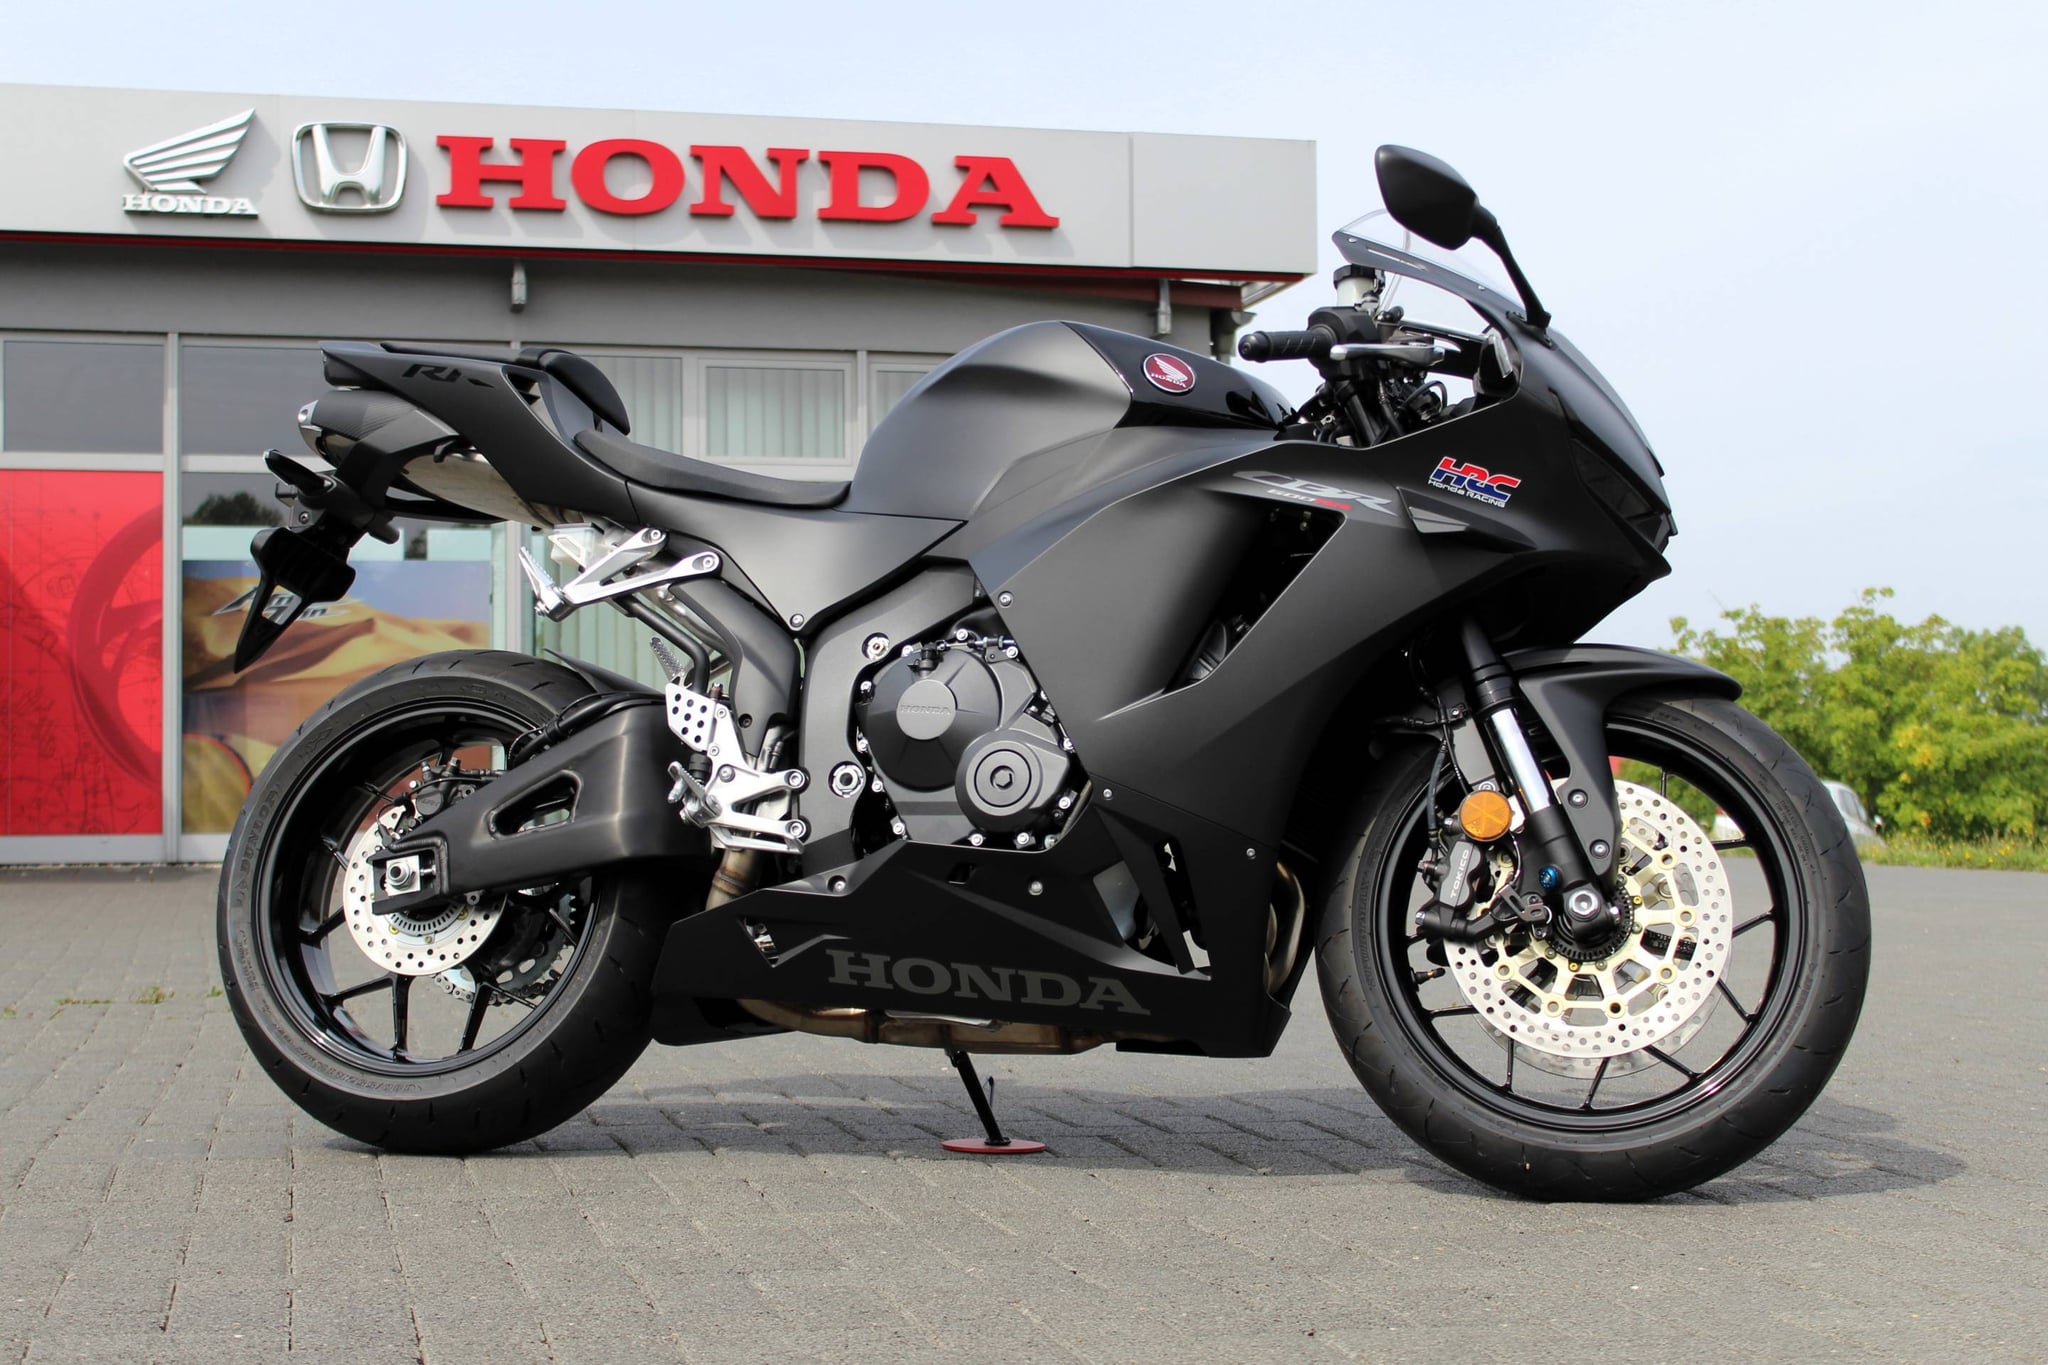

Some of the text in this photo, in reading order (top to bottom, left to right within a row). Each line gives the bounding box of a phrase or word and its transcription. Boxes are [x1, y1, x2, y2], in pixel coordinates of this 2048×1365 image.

[123, 194, 258, 217] HONDA
[436, 136, 1060, 229] HONDA
[1428, 480, 1506, 508] Honda RACING
[1429, 456, 1521, 503] HRC
[900, 704, 952, 716] HONDA
[1450, 849, 1469, 899] TOKICO
[825, 949, 1151, 1015] HONDA
